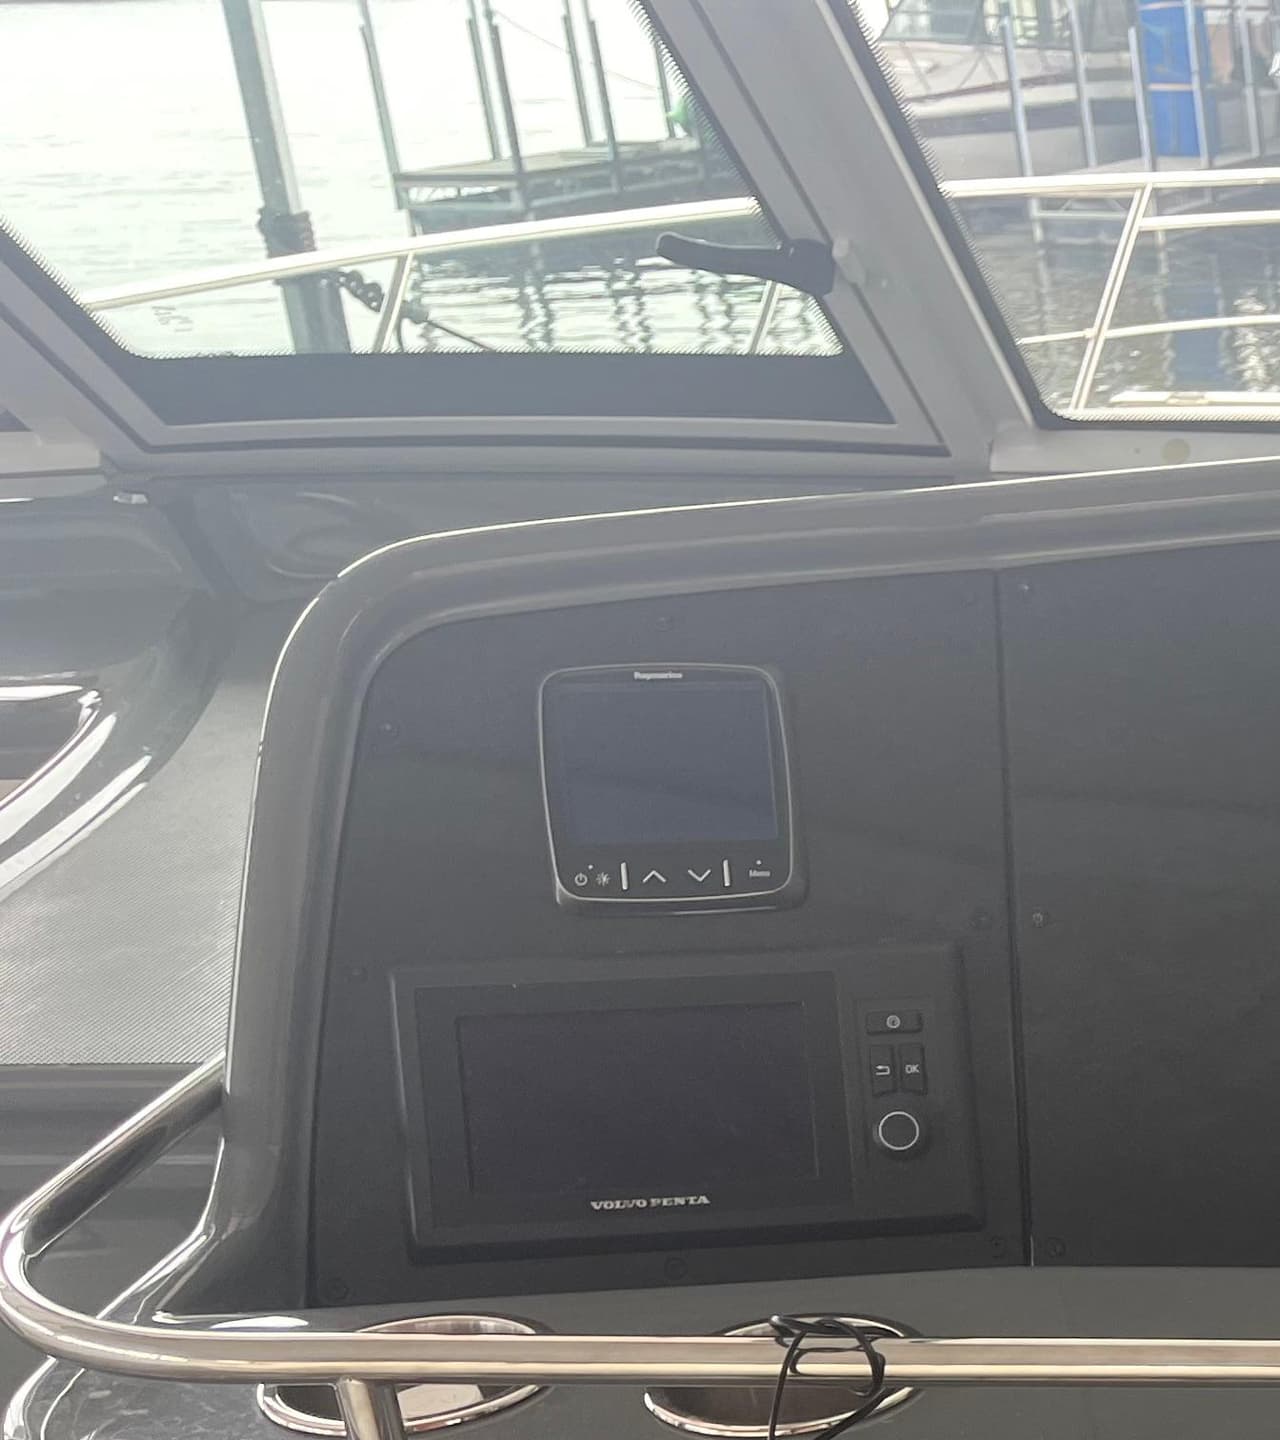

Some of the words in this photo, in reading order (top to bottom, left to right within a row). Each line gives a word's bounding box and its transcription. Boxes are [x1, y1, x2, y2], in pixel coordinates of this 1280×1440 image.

[904, 1063, 920, 1075] OK
[590, 1198, 648, 1211] VOLVO
[650, 1194, 712, 1207] PENTA
